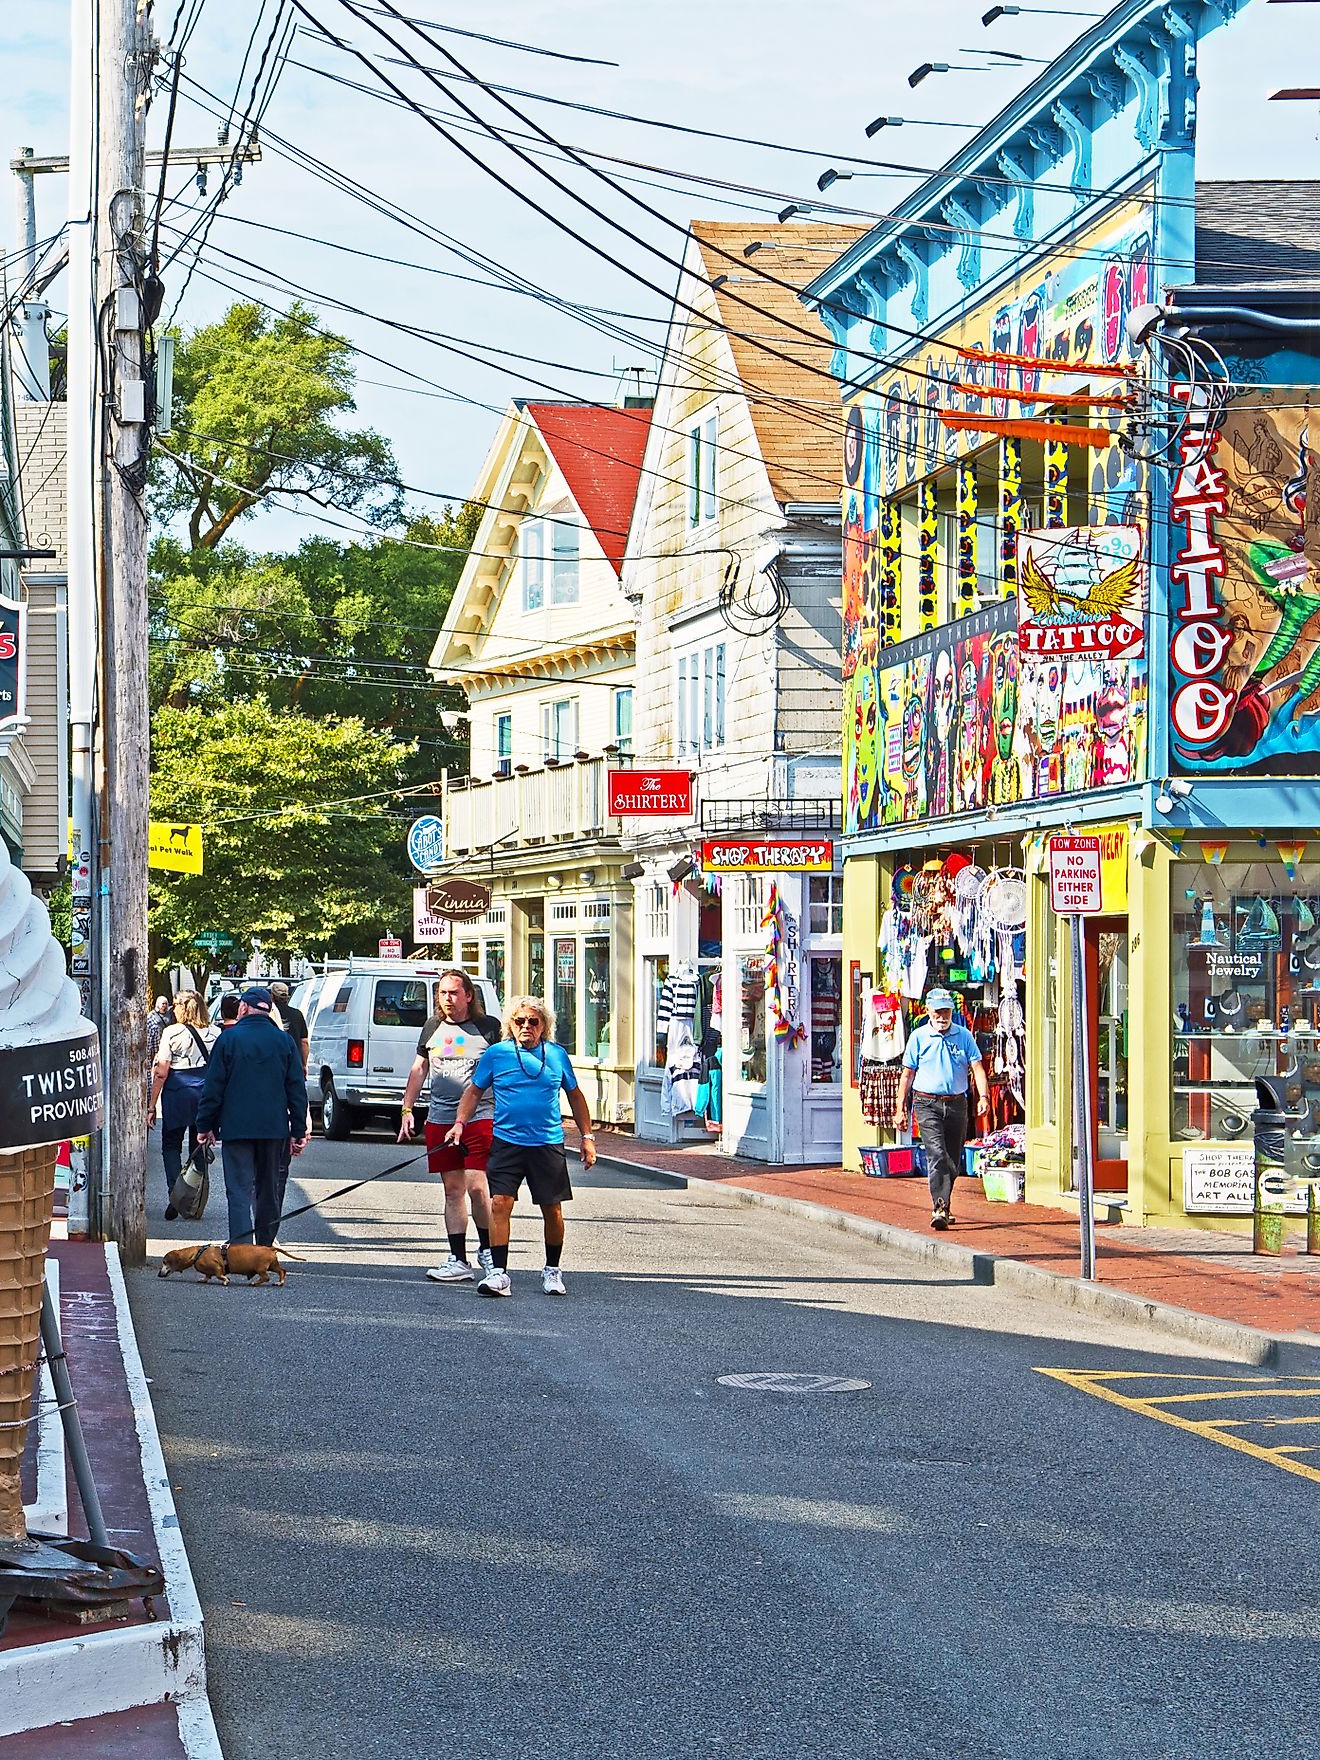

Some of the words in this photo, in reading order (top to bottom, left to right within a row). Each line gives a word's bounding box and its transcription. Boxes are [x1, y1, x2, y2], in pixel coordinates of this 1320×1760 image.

[1171, 383, 1235, 742] TATTOO
[909, 634, 940, 658] SHOP
[948, 607, 1010, 643] THERAPY
[1026, 624, 1135, 650] TATTOO
[1078, 652, 1103, 660] ALLEY
[640, 777, 661, 791] The
[614, 794, 687, 809] SHIRTERY
[1053, 838, 1070, 849] TOW
[1074, 838, 1097, 849] ZONE
[1099, 831, 1124, 860] WELRY
[174, 848, 193, 857] Walk
[711, 846, 750, 866] SHOP
[753, 845, 826, 866] THERAPY
[1067, 856, 1084, 866] NO
[1055, 869, 1097, 879] PARKING
[1058, 882, 1093, 892] EITHER
[430, 889, 487, 912] Zinnia
[1064, 895, 1089, 905] SIDE
[418, 916, 446, 927] SHELL
[419, 928, 445, 936] SHOP
[1205, 952, 1262, 964] Nautical
[787, 926, 798, 1023] SHIRTERY
[1207, 965, 1261, 979] Jewelry
[22, 1063, 98, 1098] TWISTED
[1209, 1169, 1231, 1178] BOB
[1235, 1169, 1254, 1178] GAS
[1196, 1192, 1221, 1200] ART
[1226, 1192, 1254, 1200] ALLE
